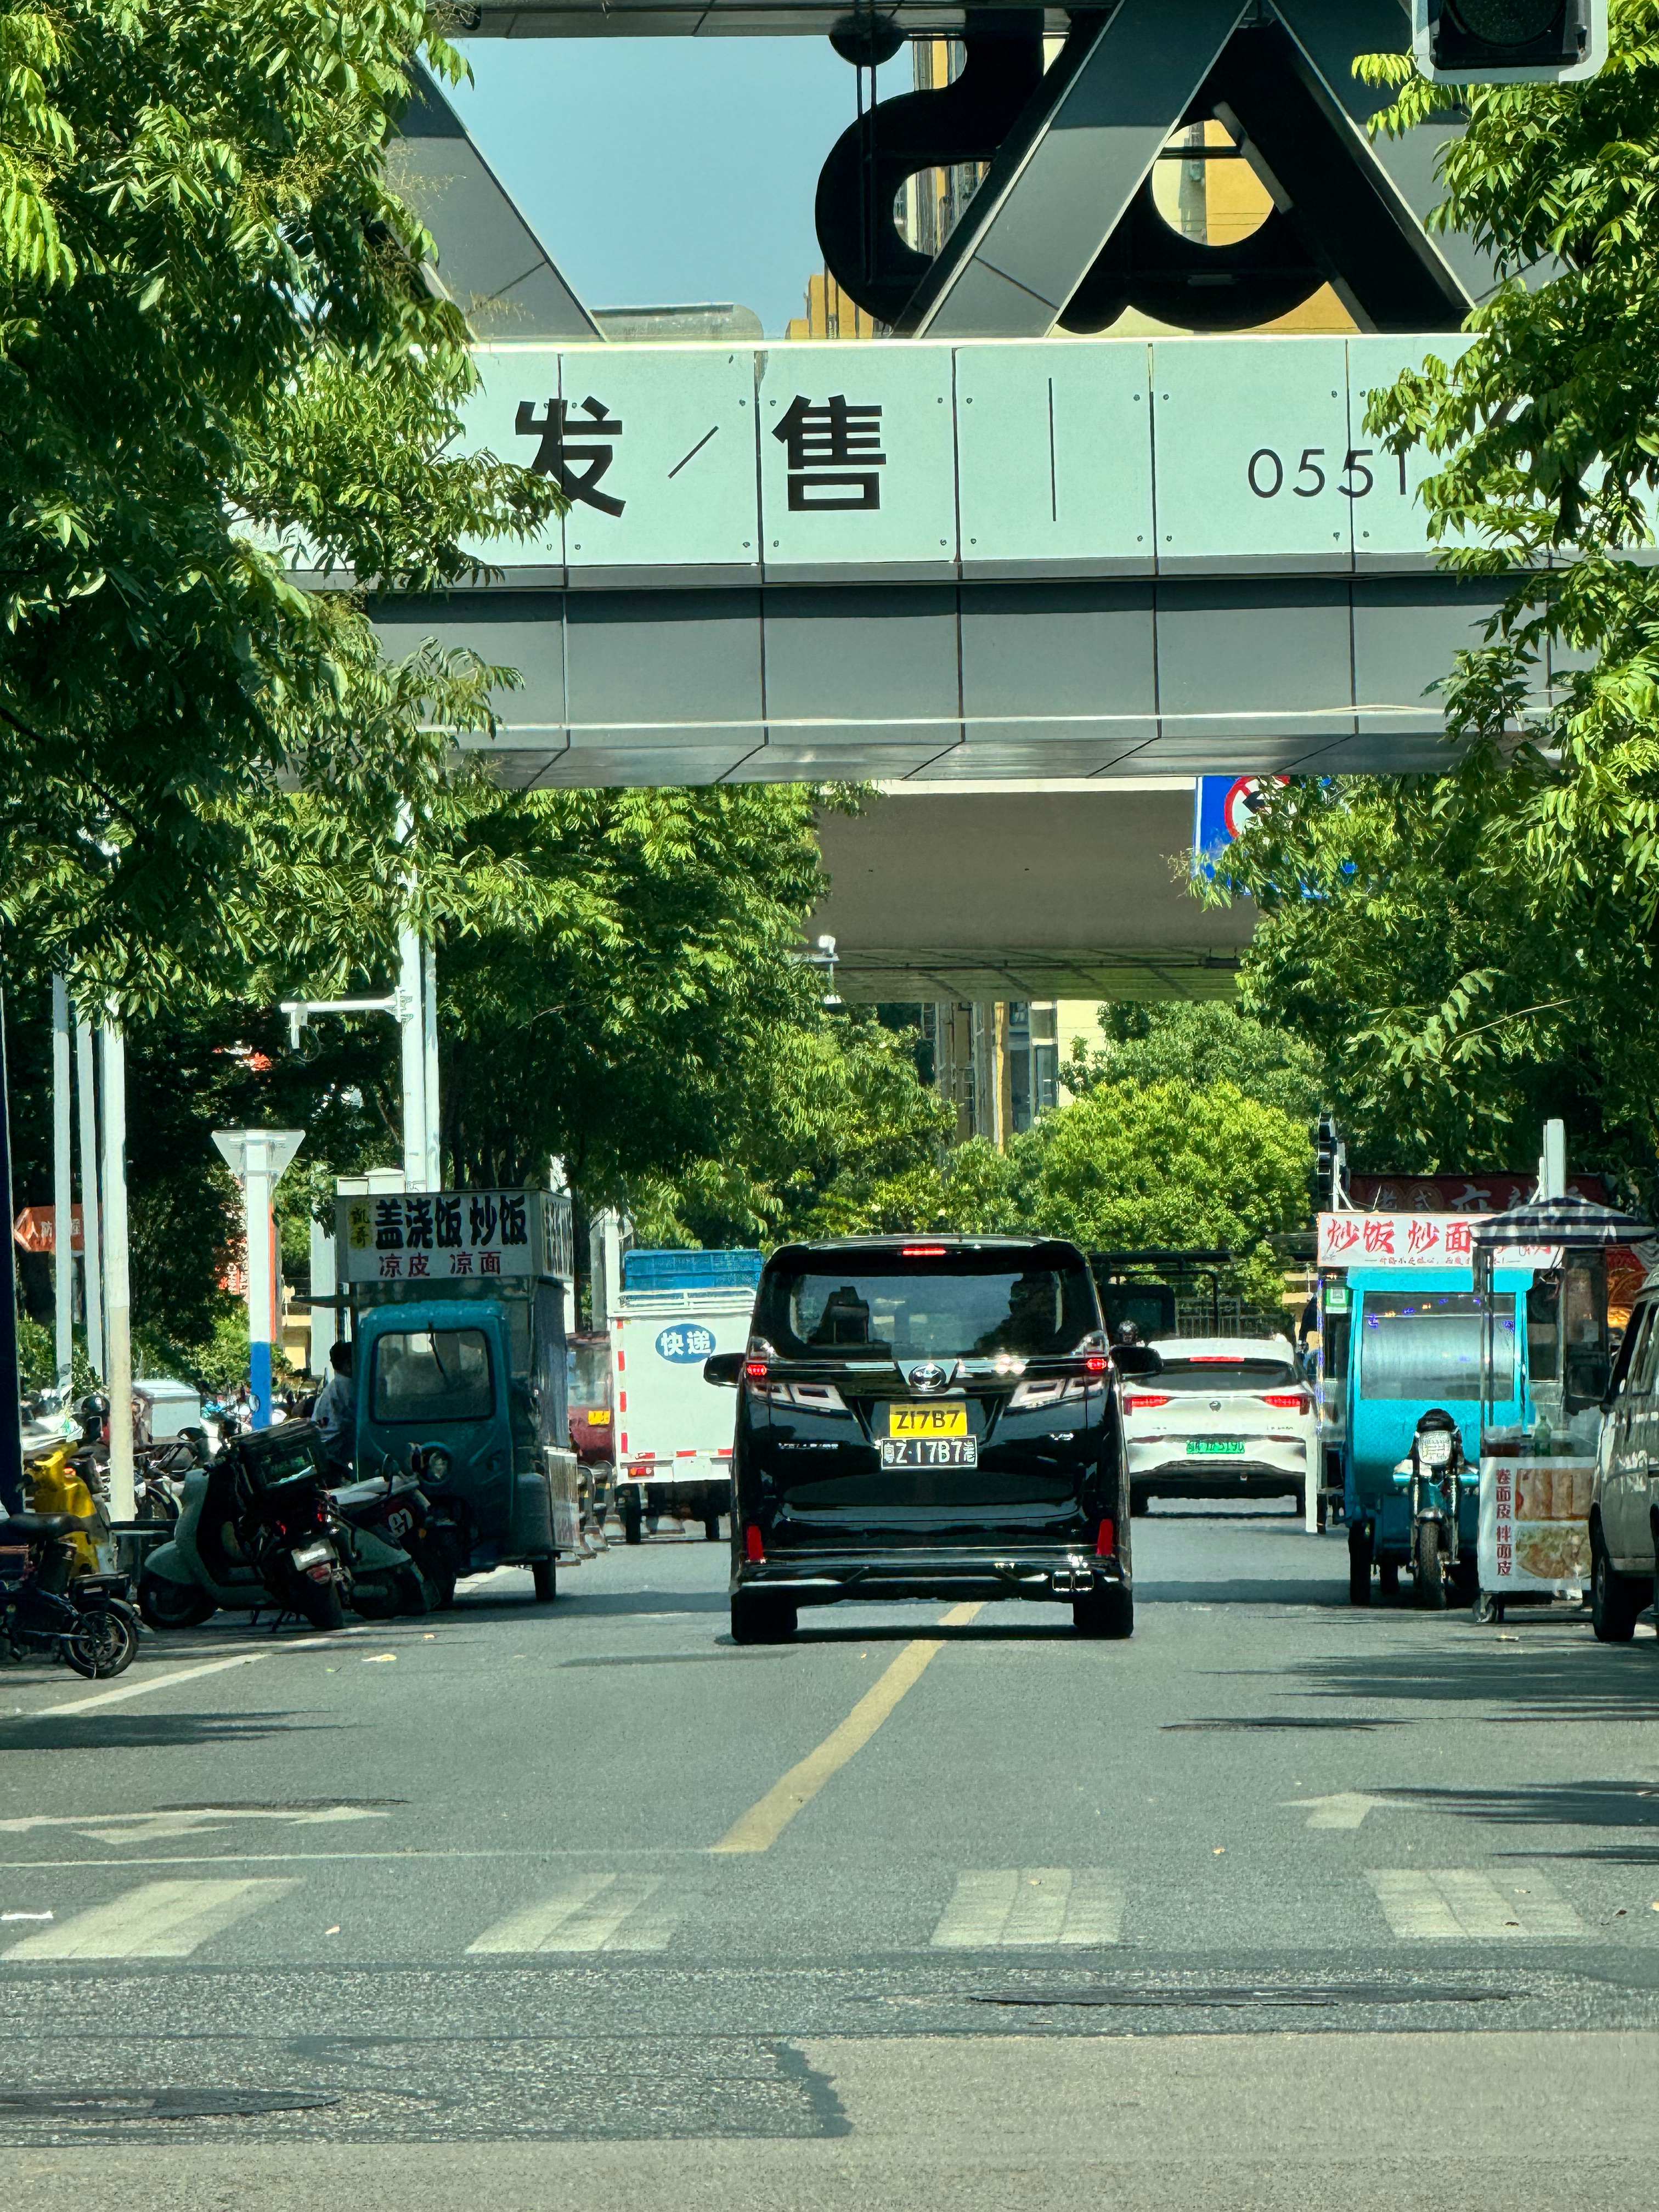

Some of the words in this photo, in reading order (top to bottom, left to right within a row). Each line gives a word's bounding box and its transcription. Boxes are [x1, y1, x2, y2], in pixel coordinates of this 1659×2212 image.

[1248, 449, 1407, 498] 0551
[1327, 1218, 1395, 1254] 炒饭
[1408, 1220, 1471, 1254] 炒面
[379, 1252, 430, 1277] 凉皮
[450, 1251, 501, 1274] 凉面
[661, 1330, 711, 1356] 快递
[895, 1410, 960, 1429] Z17B7
